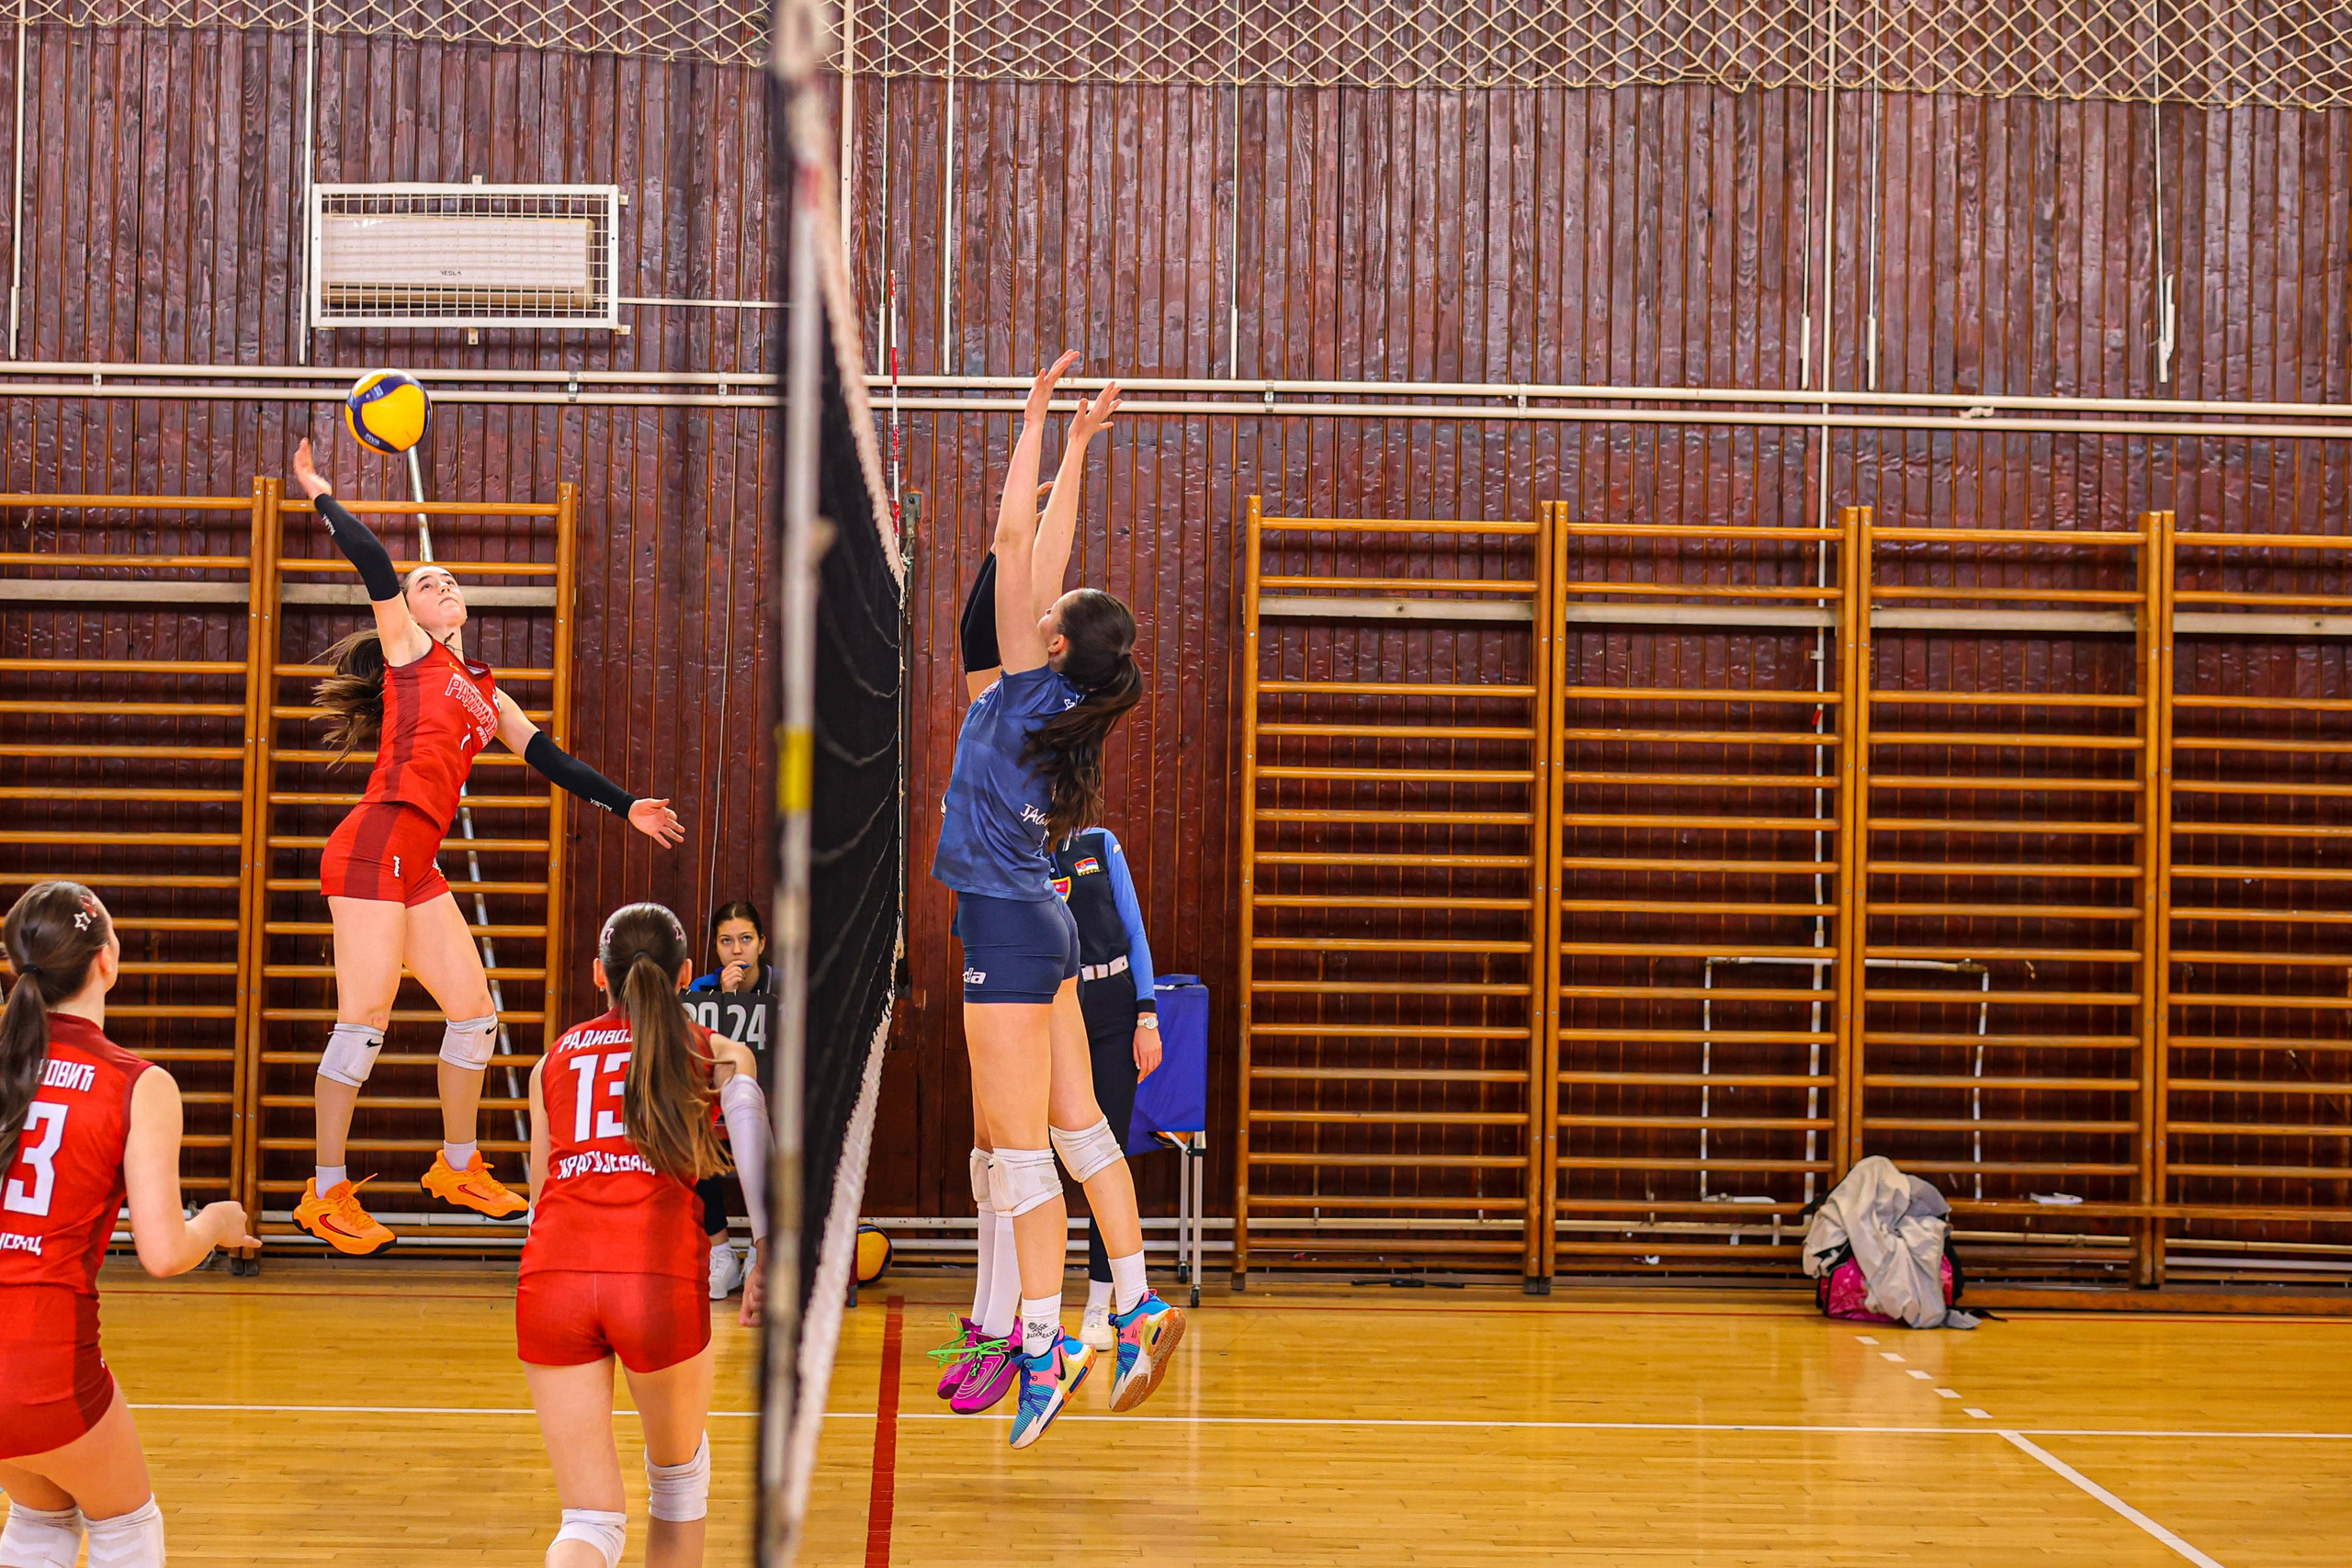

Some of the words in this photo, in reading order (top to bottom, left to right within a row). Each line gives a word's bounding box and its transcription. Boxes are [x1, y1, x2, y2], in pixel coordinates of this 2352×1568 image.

[727, 1003, 766, 1050] 24
[36, 1058, 96, 1092] ОВИЋ
[569, 1052, 632, 1144] 13
